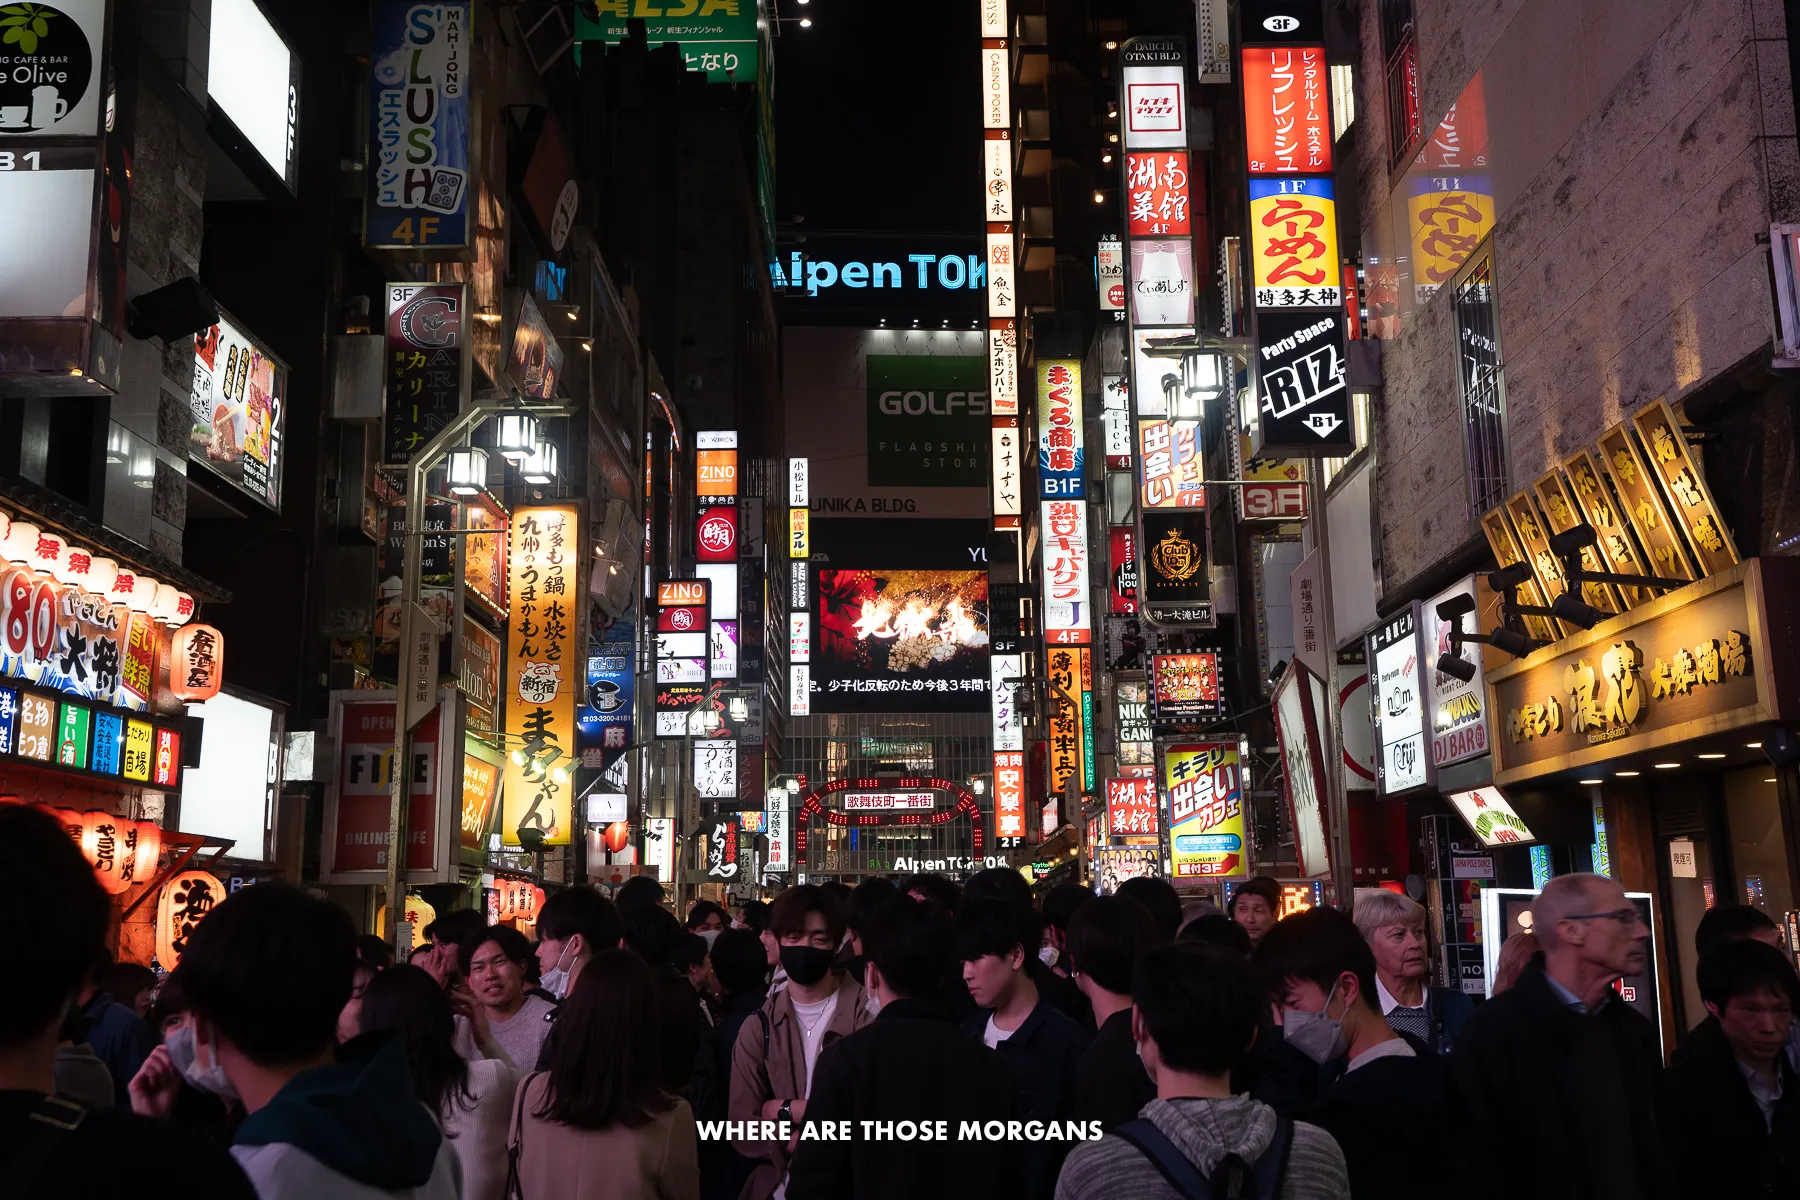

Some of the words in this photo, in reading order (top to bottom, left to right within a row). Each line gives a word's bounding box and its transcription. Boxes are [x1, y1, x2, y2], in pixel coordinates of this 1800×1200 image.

[1272, 19, 1290, 30] 3F
[1160, 53, 1180, 61] BLD
[13, 66, 67, 83] Olive
[991, 53, 1000, 91] CASINO
[1302, 51, 1319, 120] レンタルルーム
[992, 94, 1000, 124] POKER
[1270, 51, 1299, 171] リフレッシュ
[381, 93, 402, 202] エスラッシュ
[1307, 126, 1322, 166] ホステル
[1128, 155, 1186, 190] 湖南
[1251, 160, 1266, 171] 2F
[1279, 181, 1306, 194] 1F
[392, 217, 440, 243] 4F
[1150, 223, 1170, 234] 4F
[393, 289, 414, 301] 3F
[993, 276, 1011, 306] 魚金
[1257, 288, 1337, 306] 博多天神
[1261, 335, 1296, 360] Party
[1294, 317, 1335, 344] Space
[1263, 344, 1342, 419] RIZ
[405, 352, 426, 450] カリーナ
[879, 392, 988, 415] GOLF5
[1048, 366, 1073, 470] まぐろ商店
[1313, 416, 1332, 428] B1
[1144, 423, 1173, 505] 出会い
[1179, 427, 1198, 481] カフェ
[700, 466, 735, 479] ZINO
[794, 461, 804, 503] 小松ビル
[1044, 478, 1080, 493] B1F
[872, 499, 920, 513] BLDG.
[1182, 494, 1202, 505] 1F
[1247, 488, 1302, 515] 3F
[1012, 518, 1019, 527] 4
[35, 533, 60, 560] 祭
[544, 514, 566, 596] 博多もつ鍋
[1046, 502, 1083, 599] 熟女キャバクラ
[68, 553, 91, 574] 祭
[112, 574, 134, 594] 祭
[517, 516, 541, 658] 九州のうまかもん
[662, 583, 703, 599] ZINO
[67, 590, 118, 630] やきとん
[178, 597, 192, 615] 祭
[1154, 610, 1210, 620] 第一大滝ビル
[1299, 578, 1316, 653] 劇場通り一番街
[130, 619, 156, 652] 旨い
[543, 600, 566, 661] 水炊き
[725, 626, 736, 635] 2F
[1057, 631, 1080, 643] 4F
[995, 642, 1015, 650] 3F
[187, 630, 215, 689] 居酒屋
[416, 632, 430, 702] 劇場通り一番街
[588, 657, 625, 670] BLUE
[1651, 629, 1750, 700] 大衆酒場
[122, 652, 151, 696] 鮮魚
[521, 677, 556, 692] 新宿
[533, 691, 544, 701] の
[21, 696, 49, 727] 名物
[362, 716, 394, 730] OPEN
[1118, 704, 1147, 719] NIK
[17, 731, 49, 762] もつ煮
[60, 704, 78, 766] 旨い酒
[1434, 740, 1448, 765] DJ
[1450, 730, 1475, 758] BAR
[1587, 731, 1606, 745] Naniwa
[349, 754, 428, 783] FIE
[719, 741, 733, 785] 居酒屋
[995, 754, 1022, 766] 焼肉
[1172, 744, 1225, 780] キラリ
[847, 795, 932, 808] 歌舞伎町一番街
[1111, 778, 1157, 809] 湖南
[1173, 765, 1235, 821] 出会い
[1199, 798, 1240, 832] カフェ
[1595, 807, 1604, 825] EL
[345, 832, 391, 845] ONLINE
[1001, 838, 1020, 847] 2F
[1494, 829, 1521, 843] OPEN
[894, 857, 945, 873] Alpen
[1180, 864, 1222, 875] 受付3F
[1673, 852, 1692, 866] 喫煙可
